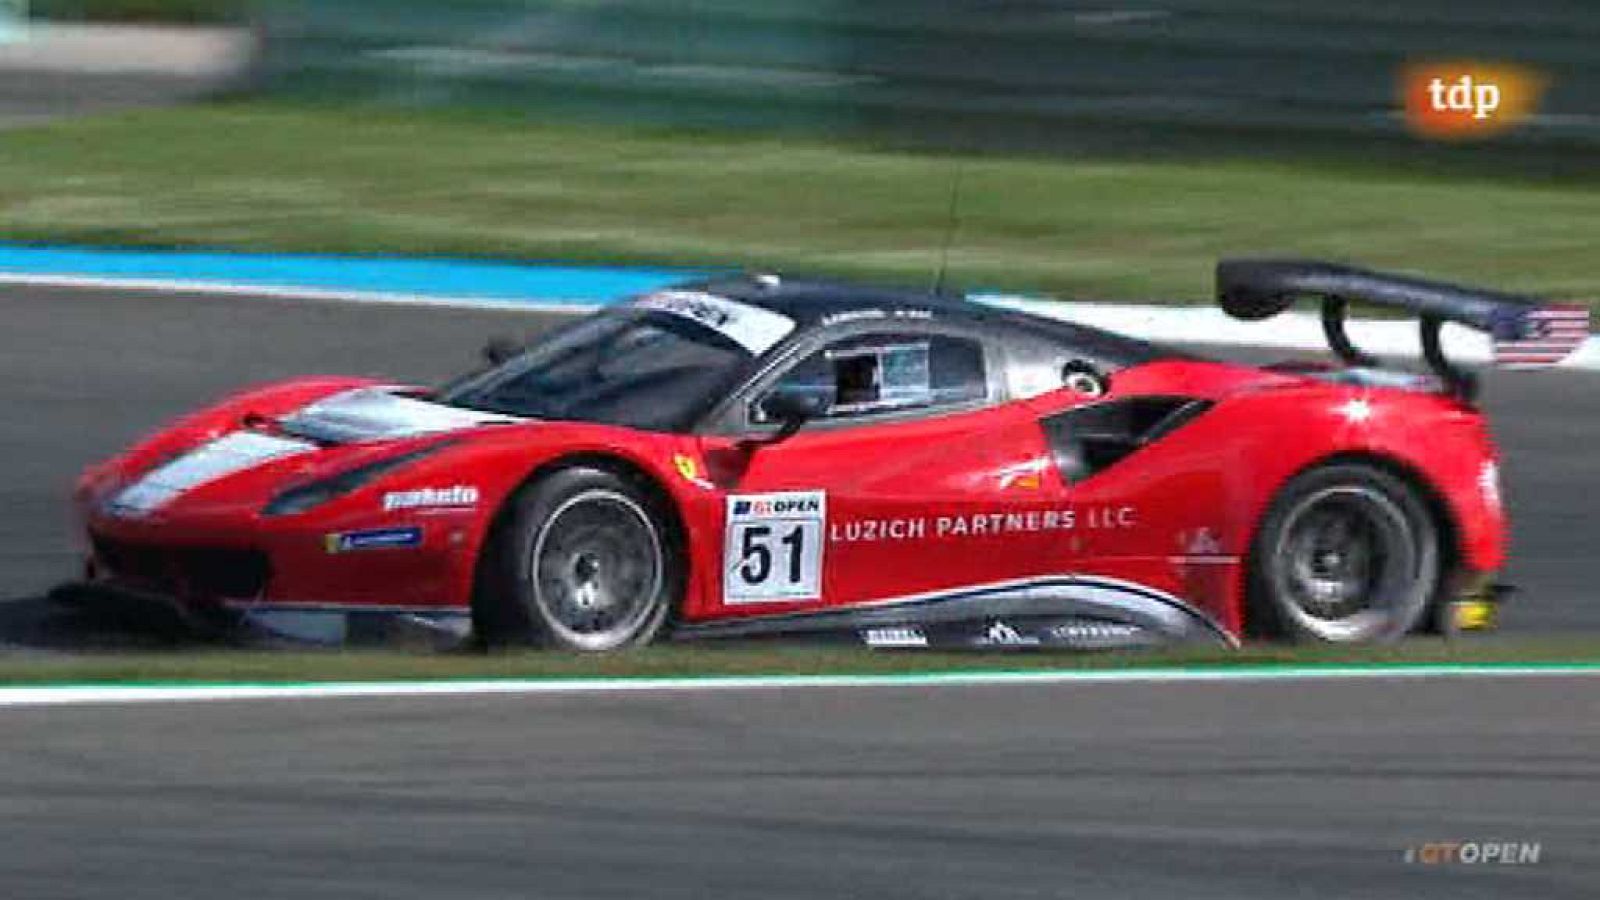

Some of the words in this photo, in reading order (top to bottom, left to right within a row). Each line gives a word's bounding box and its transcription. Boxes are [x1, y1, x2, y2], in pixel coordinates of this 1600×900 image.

[830, 516, 925, 542] LUZICH
[936, 510, 1076, 538] PARTNERS
[1087, 507, 1137, 530] LLC
[741, 525, 803, 584] 51
